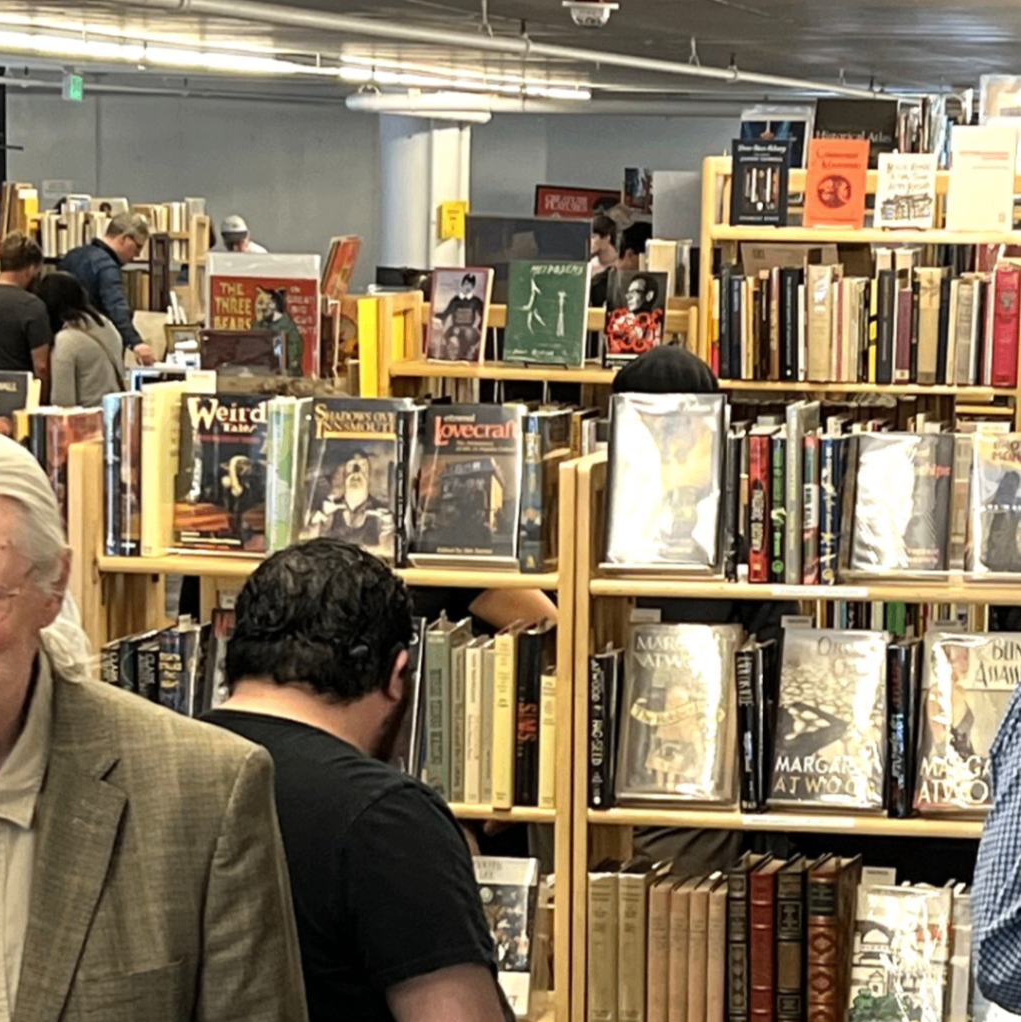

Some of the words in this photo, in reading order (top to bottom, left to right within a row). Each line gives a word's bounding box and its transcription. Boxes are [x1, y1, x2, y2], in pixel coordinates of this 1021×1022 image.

[869, 131, 893, 143] Atlas
[219, 282, 245, 296] THE
[214, 296, 252, 314] THREE
[214, 316, 252, 331] BEARS
[187, 397, 268, 429] Weird
[221, 422, 258, 434] Tales
